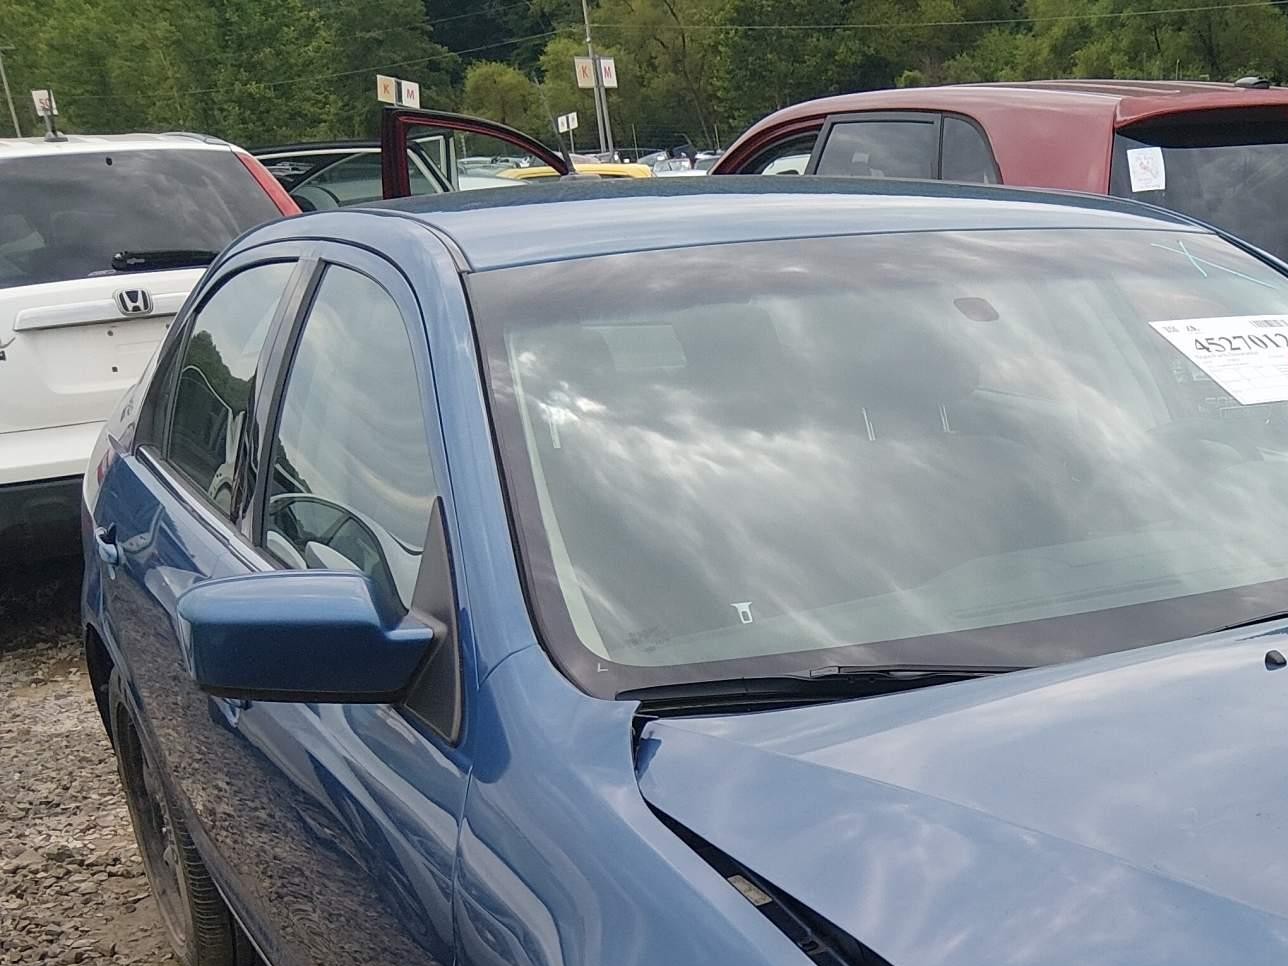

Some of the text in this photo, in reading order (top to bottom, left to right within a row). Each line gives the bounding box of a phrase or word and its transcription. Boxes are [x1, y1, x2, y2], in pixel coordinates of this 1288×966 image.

[581, 65, 590, 80] K
[604, 66, 612, 79] M
[383, 84, 390, 95] K
[406, 88, 416, 100] M
